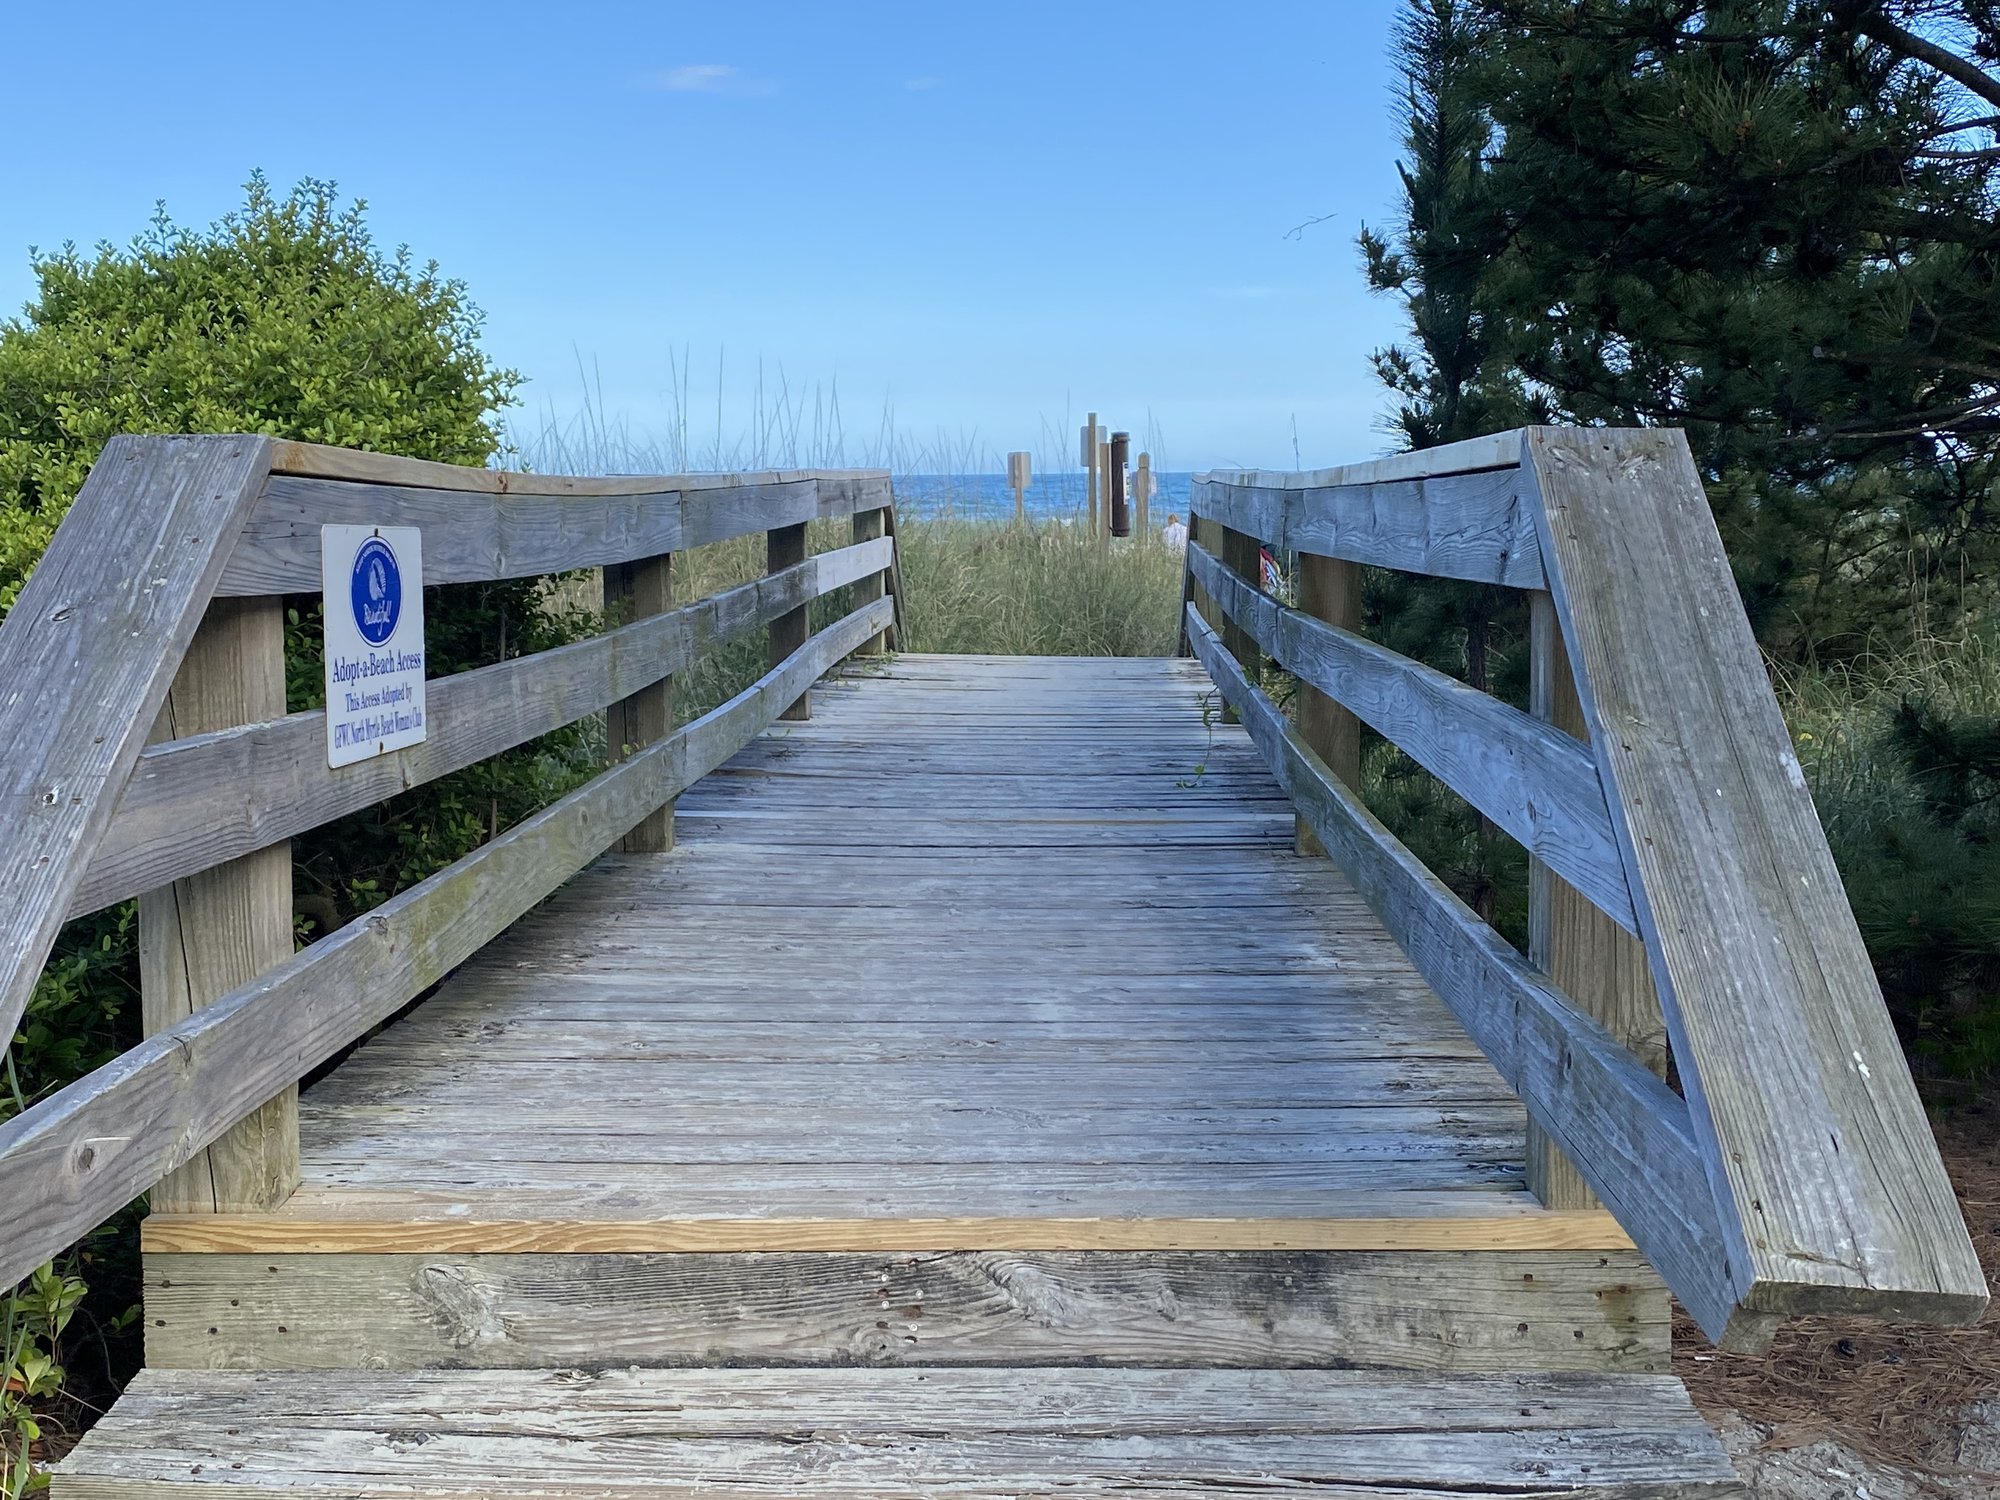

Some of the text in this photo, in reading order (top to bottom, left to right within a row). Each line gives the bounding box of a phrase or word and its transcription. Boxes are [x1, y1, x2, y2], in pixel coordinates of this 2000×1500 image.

[332, 649, 421, 686] Adopt-a-Beach Access
[345, 682, 413, 712] This Access Adopted by
[351, 719, 365, 744] North
[365, 715, 380, 745] Myrtle
[380, 712, 394, 737] Beach
[412, 705, 422, 728] Club
